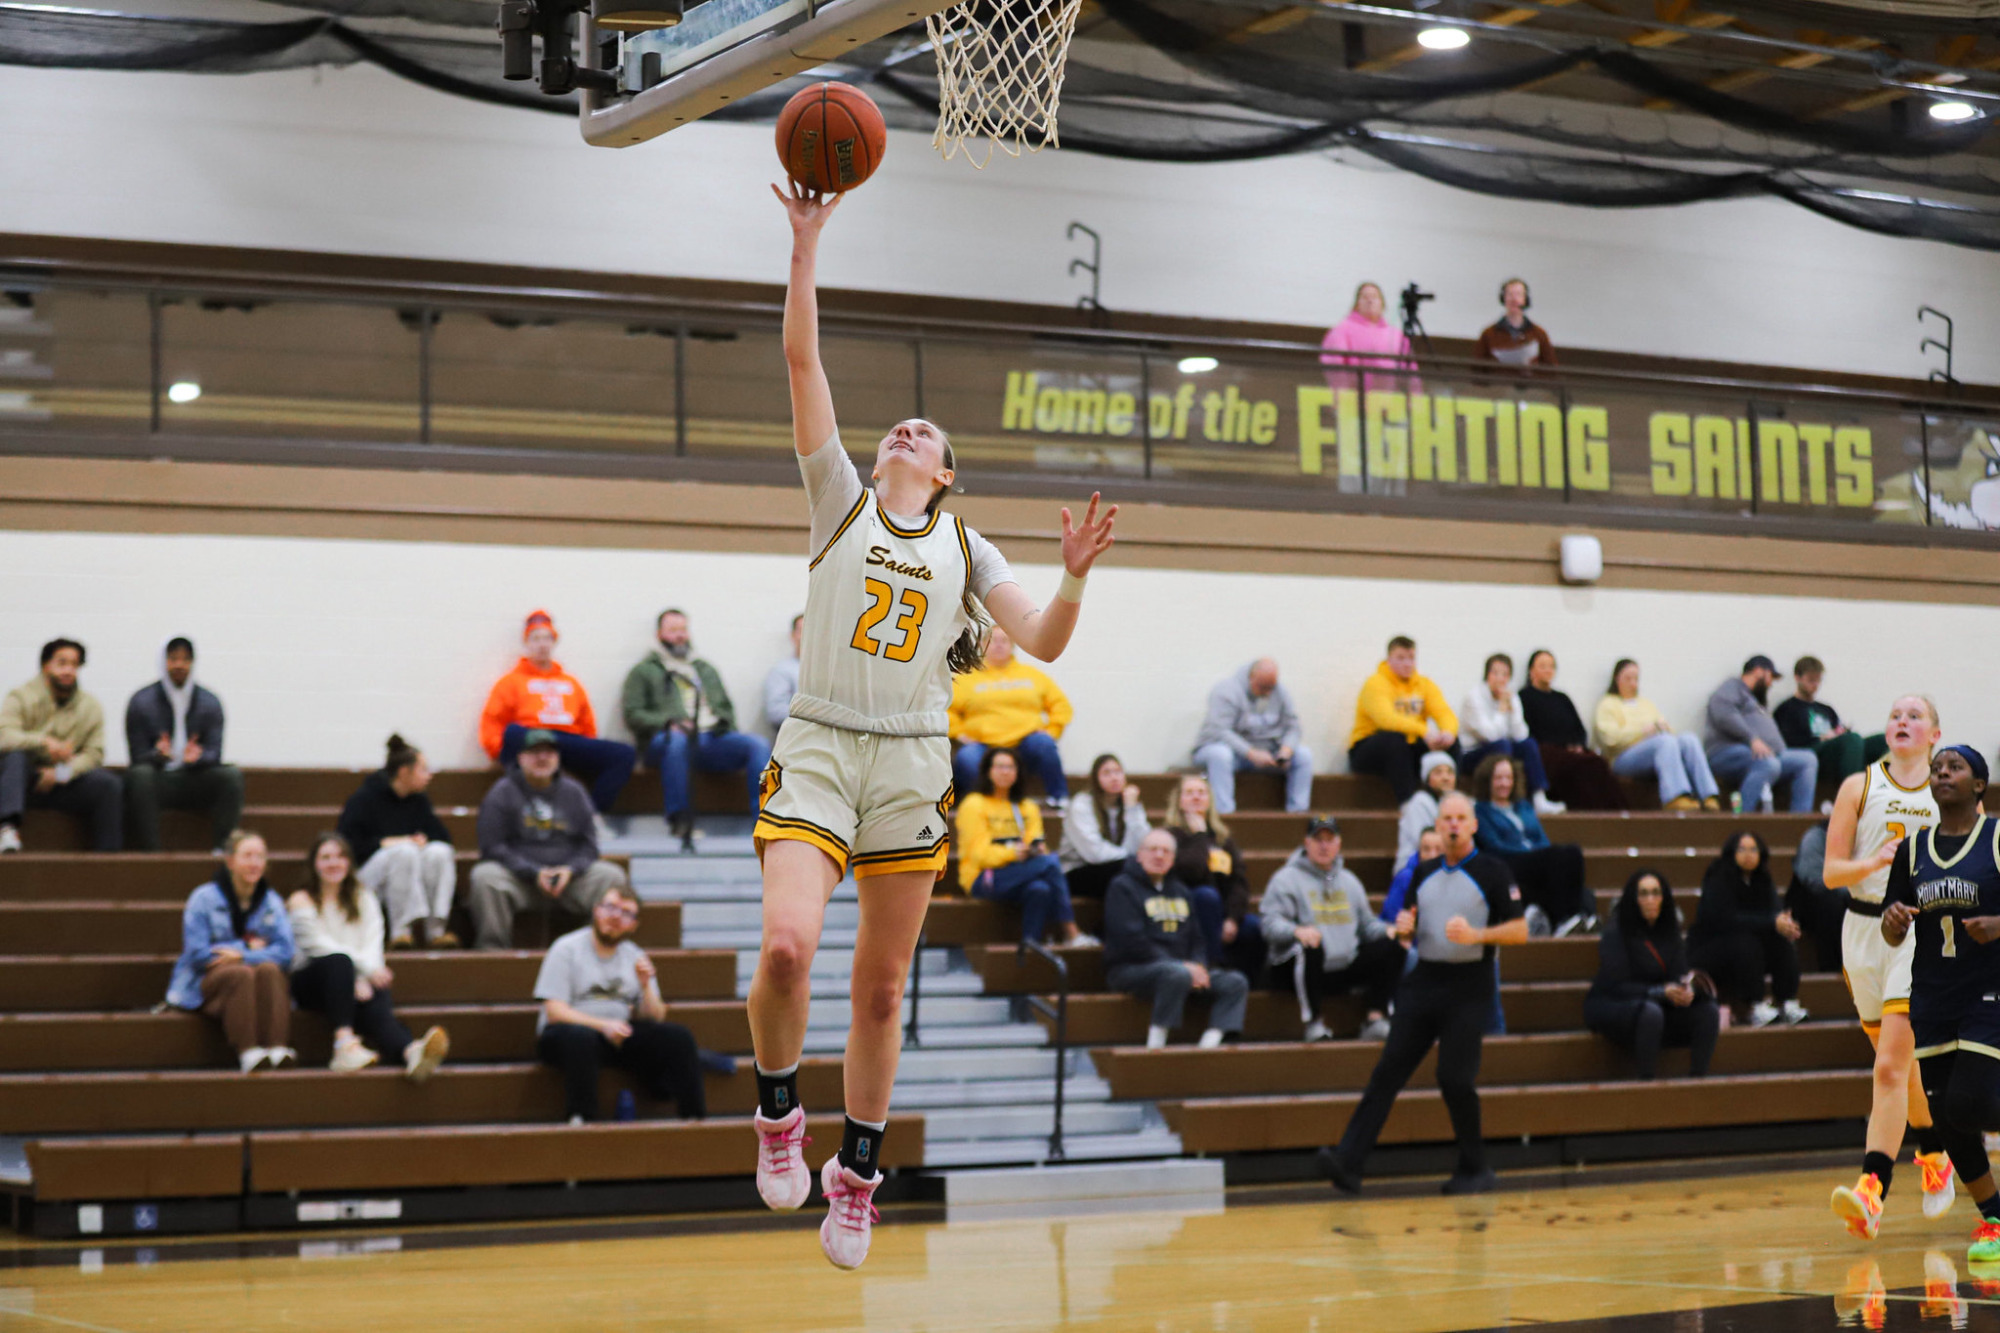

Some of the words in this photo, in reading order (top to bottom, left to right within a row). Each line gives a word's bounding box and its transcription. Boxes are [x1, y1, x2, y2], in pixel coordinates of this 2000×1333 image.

[1002, 371, 1136, 436] Home
[1149, 382, 1196, 439] of
[1202, 385, 1278, 445] the
[1297, 385, 1611, 491] FIGHTING
[1650, 412, 1874, 507] SAINTS
[865, 545, 934, 581] Saints
[850, 576, 929, 662] 23
[1885, 800, 1932, 817] Saints
[1940, 915, 1956, 957] 1
